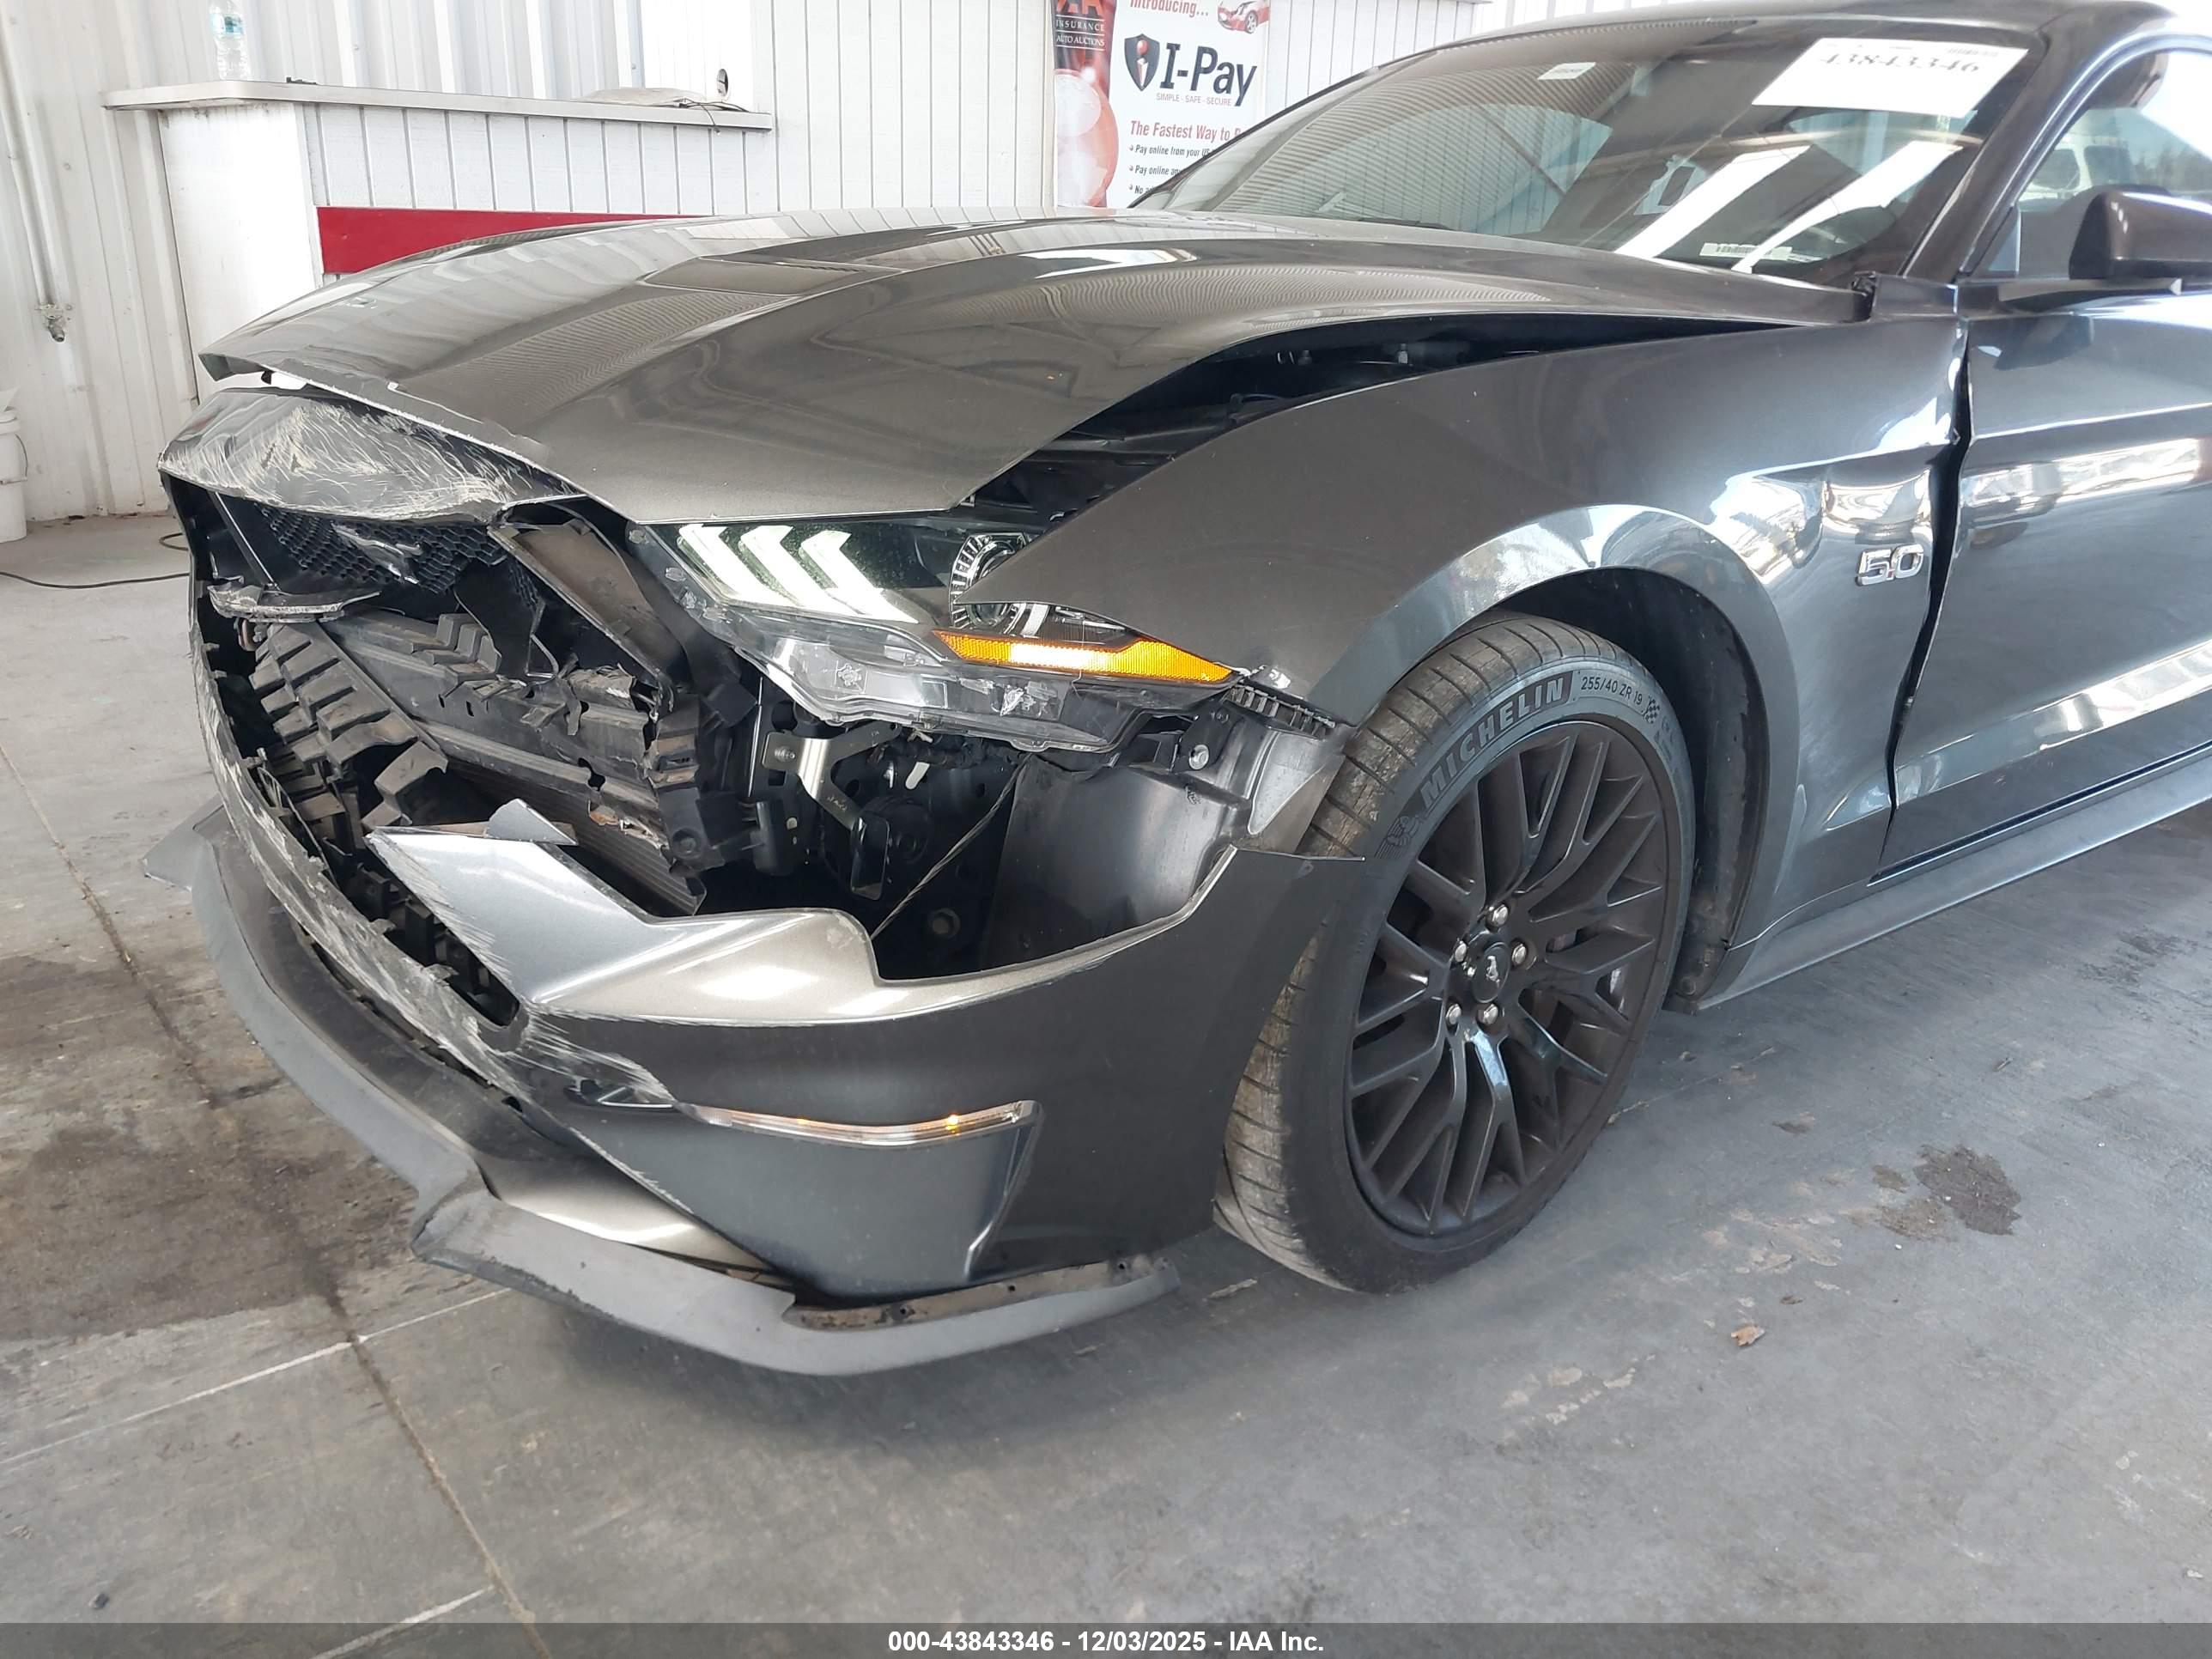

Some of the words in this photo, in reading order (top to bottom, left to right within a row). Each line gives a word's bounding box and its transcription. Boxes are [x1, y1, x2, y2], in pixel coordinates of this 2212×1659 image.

[1056, 19, 1105, 32] INSURANCE
[1056, 34, 1073, 44] AUTO
[1073, 36, 1105, 46] AUCTIONS
[1159, 42, 1258, 106] I-Pay
[1156, 93, 1180, 102] SIMPLE
[1185, 94, 1201, 104] SAFE
[1206, 97, 1232, 106] SECURE
[1130, 120, 1150, 136] The
[1152, 122, 1193, 138] Fastest
[1196, 125, 1217, 143] Way
[1220, 126, 1231, 141] to
[1135, 144, 1147, 155] Pay
[1149, 145, 1169, 155] online
[1170, 146, 1185, 155] from
[1186, 149, 1200, 158] your
[1135, 165, 1147, 176] Pay
[1149, 166, 1169, 176] online
[1134, 185, 1143, 194] No
[1420, 677, 1564, 808] MICHELIN
[1581, 676, 1619, 693] 255/40
[1620, 684, 1632, 699] ZR
[1634, 690, 1644, 705] 19
